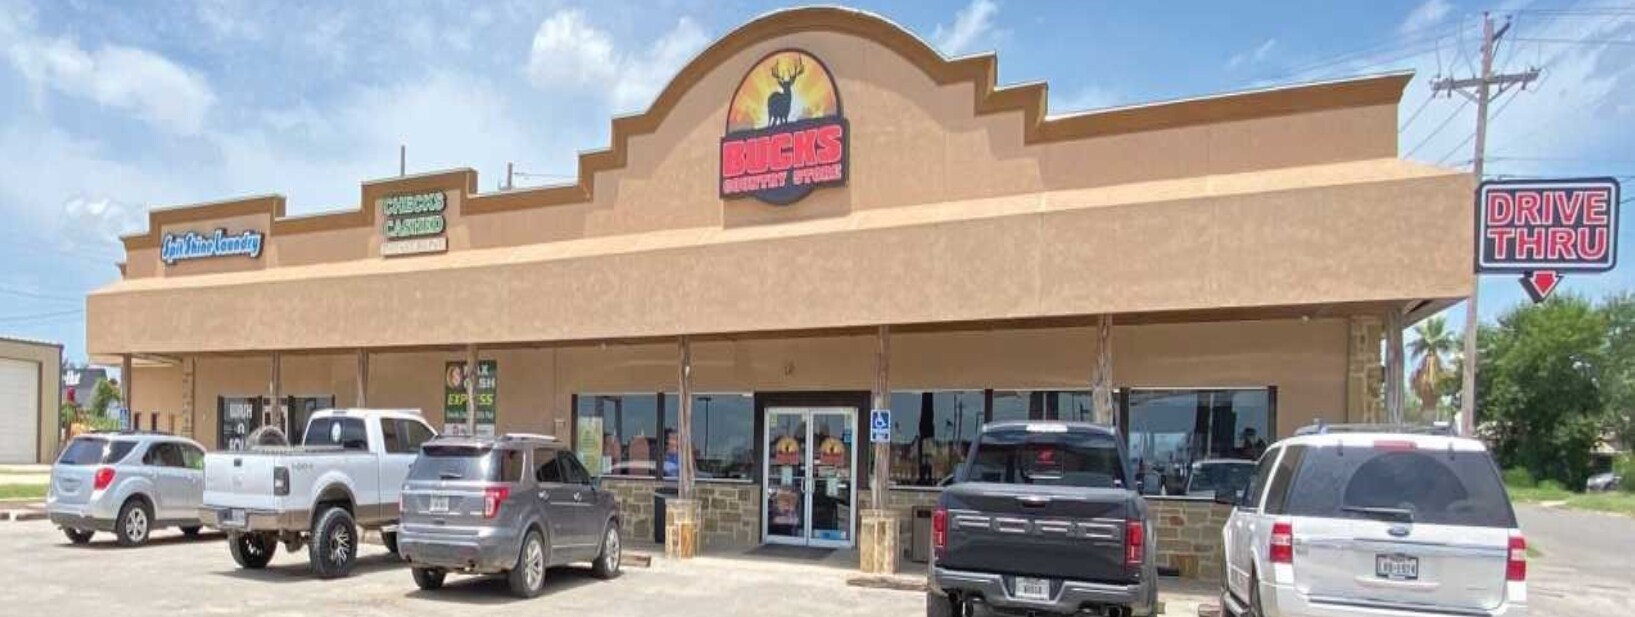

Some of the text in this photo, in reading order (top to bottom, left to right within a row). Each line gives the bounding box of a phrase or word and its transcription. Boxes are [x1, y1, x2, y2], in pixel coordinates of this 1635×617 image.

[722, 125, 842, 177] BUCKS
[723, 163, 842, 193] COUNTRY STORE
[384, 192, 444, 214] CHECKS
[1487, 190, 1608, 226] DRIVE
[384, 215, 444, 238] CASHED
[162, 229, 261, 263] Spit Shine Laundry
[1487, 227, 1607, 260] THRU
[463, 377, 496, 389] CSH
[951, 514, 1121, 541] FORD
